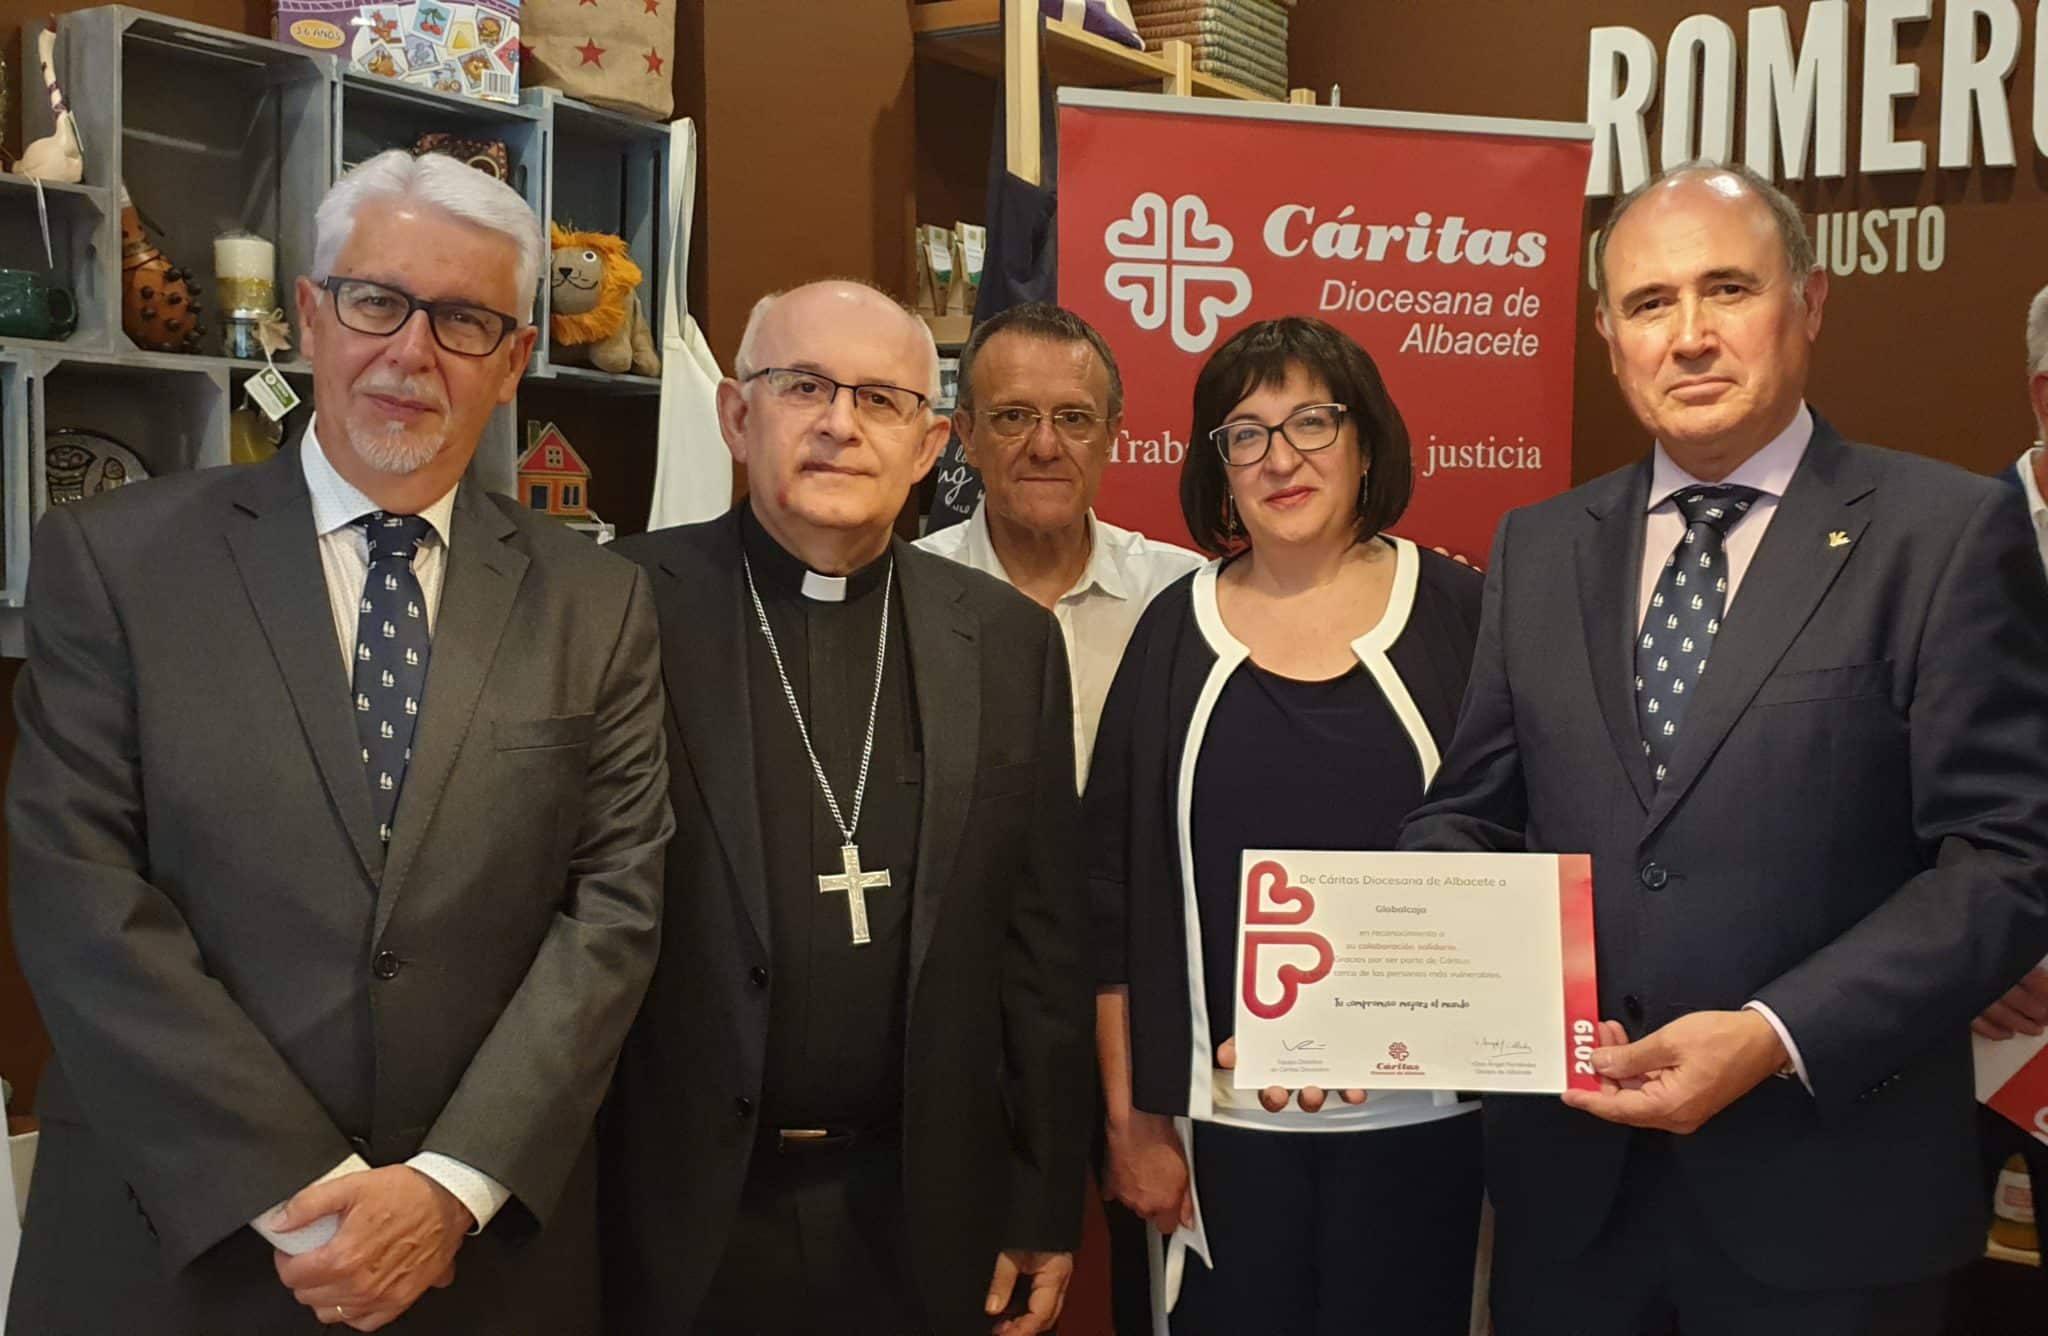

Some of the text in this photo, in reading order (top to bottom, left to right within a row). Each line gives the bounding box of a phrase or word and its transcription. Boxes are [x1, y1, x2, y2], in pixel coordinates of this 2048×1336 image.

[1585, 0, 2048, 197] ROMER
[1263, 204, 1548, 268] Cáritas
[1816, 205, 1945, 276] JUSTO
[1319, 279, 1541, 318] Diocesana de
[1399, 323, 1540, 357] Albacete
[1110, 430, 1542, 477] Trab justicia
[1299, 873, 1507, 887] De Cáritas Diocesana de Albacete a
[1375, 904, 1427, 915] Globalcaja
[1334, 997, 1471, 1011] Tu compromiso mejora el mundo
[1573, 1019, 1595, 1075] 2019
